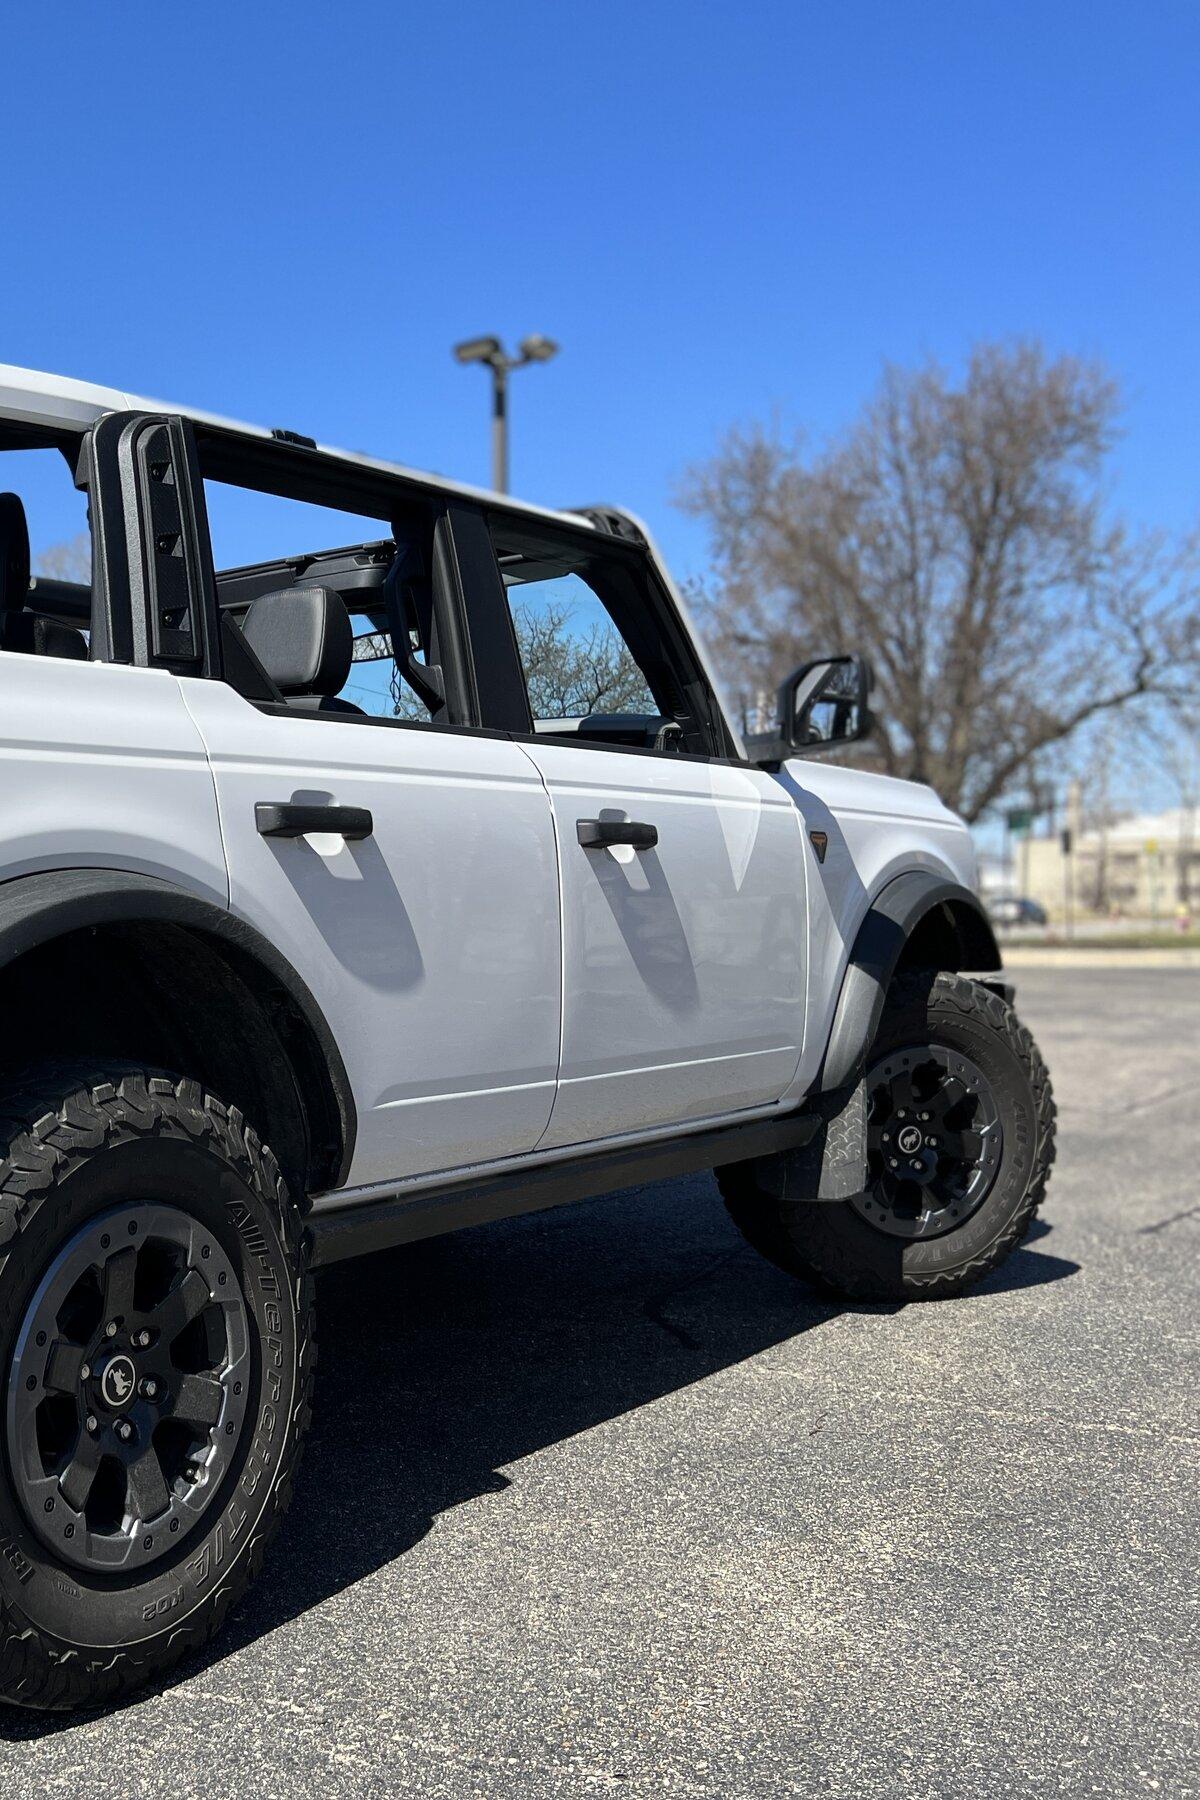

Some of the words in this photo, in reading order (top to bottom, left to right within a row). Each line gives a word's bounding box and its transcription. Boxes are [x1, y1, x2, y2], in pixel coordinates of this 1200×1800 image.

[225, 1200, 284, 1497] All-Terrain
[184, 1502, 248, 1588] T/A
[142, 1584, 185, 1620] KO2
